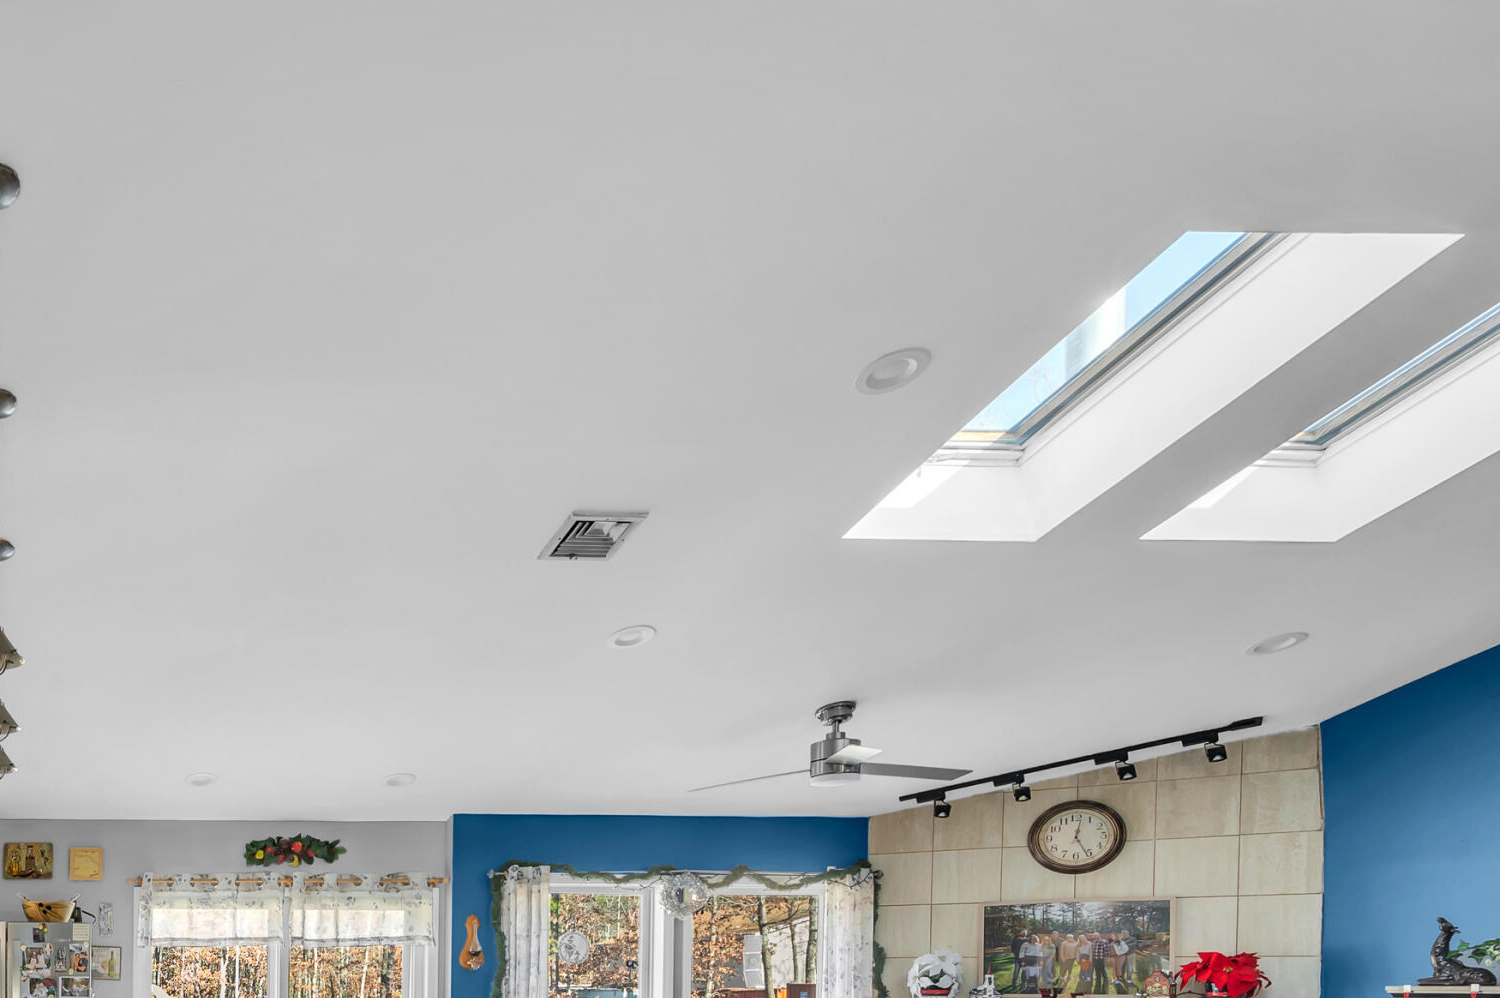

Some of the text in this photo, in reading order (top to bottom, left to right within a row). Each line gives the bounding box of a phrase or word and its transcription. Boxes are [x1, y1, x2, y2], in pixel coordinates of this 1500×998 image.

[1050, 825, 1061, 833] 10
[1050, 844, 1058, 852] 8
[1061, 850, 1068, 858] 7
[1072, 852, 1080, 860] 6
